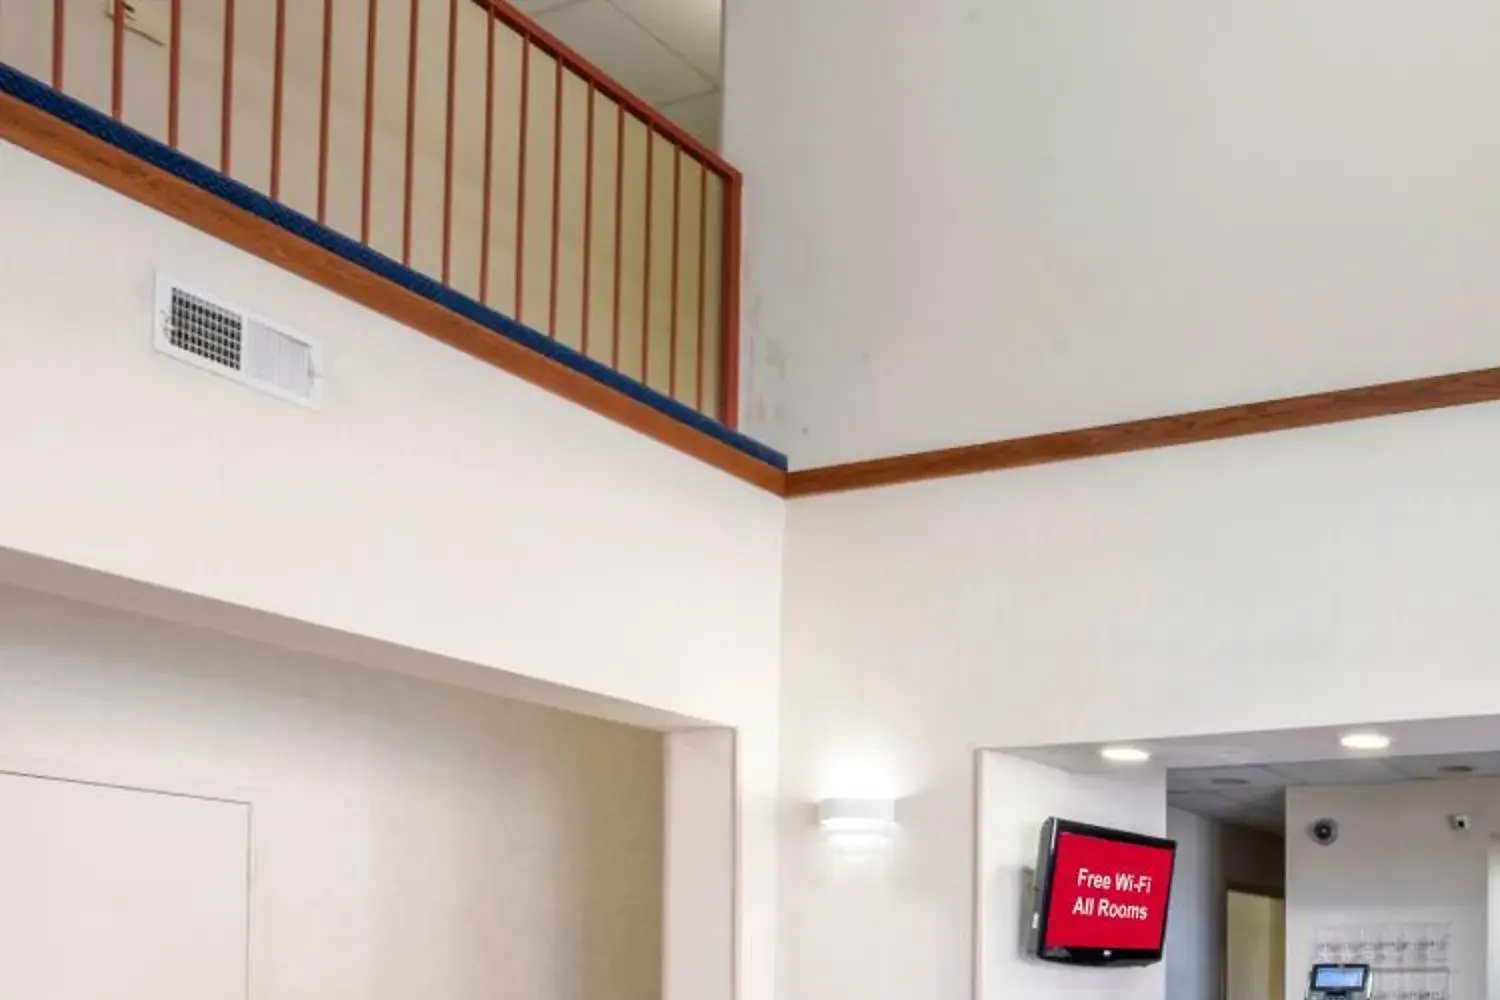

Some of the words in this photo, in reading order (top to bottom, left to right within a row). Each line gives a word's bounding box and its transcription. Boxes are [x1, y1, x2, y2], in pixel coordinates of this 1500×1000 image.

[1077, 867, 1111, 889] Free
[1115, 872, 1152, 894] Wi-Fi
[1071, 896, 1094, 916] All
[1097, 898, 1148, 920] Rooms
